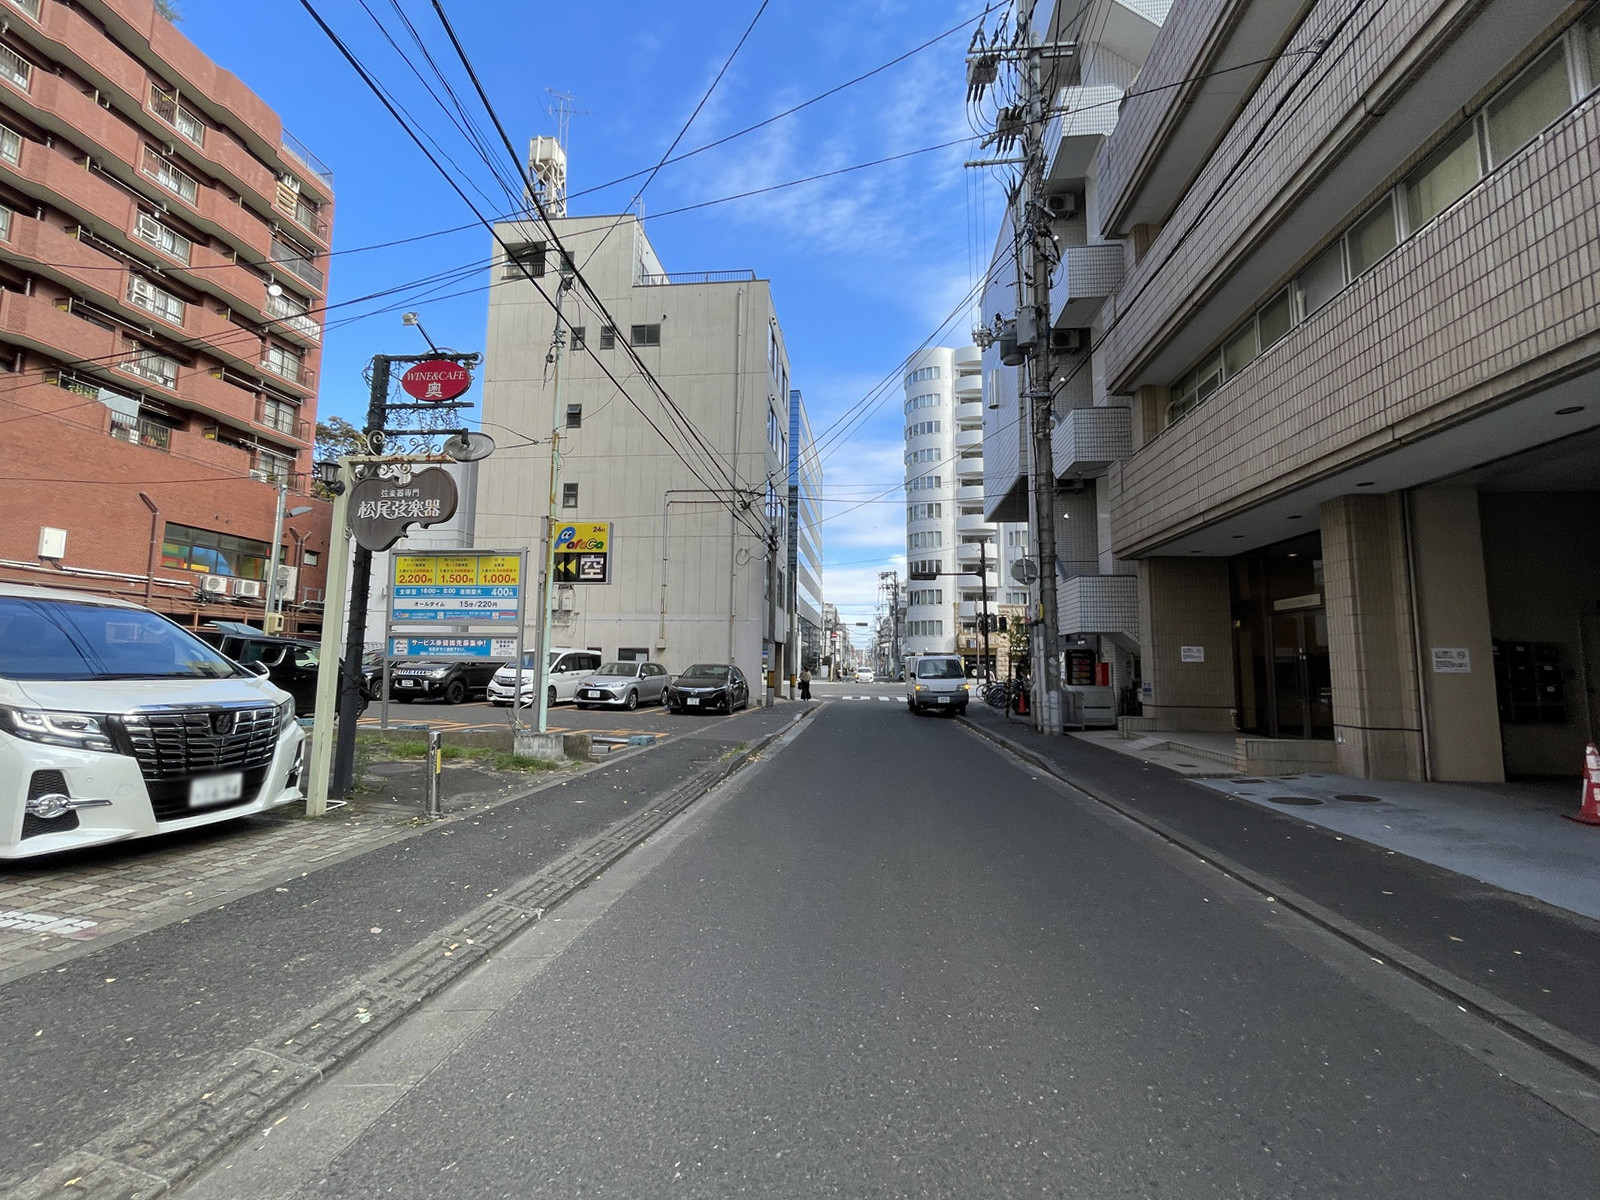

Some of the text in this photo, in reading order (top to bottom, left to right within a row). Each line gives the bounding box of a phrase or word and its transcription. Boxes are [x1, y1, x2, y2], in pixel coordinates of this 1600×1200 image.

[407, 371, 466, 381] WINE&CAFE
[425, 382, 442, 398] 奥
[381, 489, 420, 498] 弦楽器専門
[357, 499, 441, 520] 松尾弦楽器
[580, 555, 604, 579] 空
[399, 575, 432, 584] 2,200円
[441, 574, 474, 583] 1,500円
[483, 574, 516, 583] 1,000円
